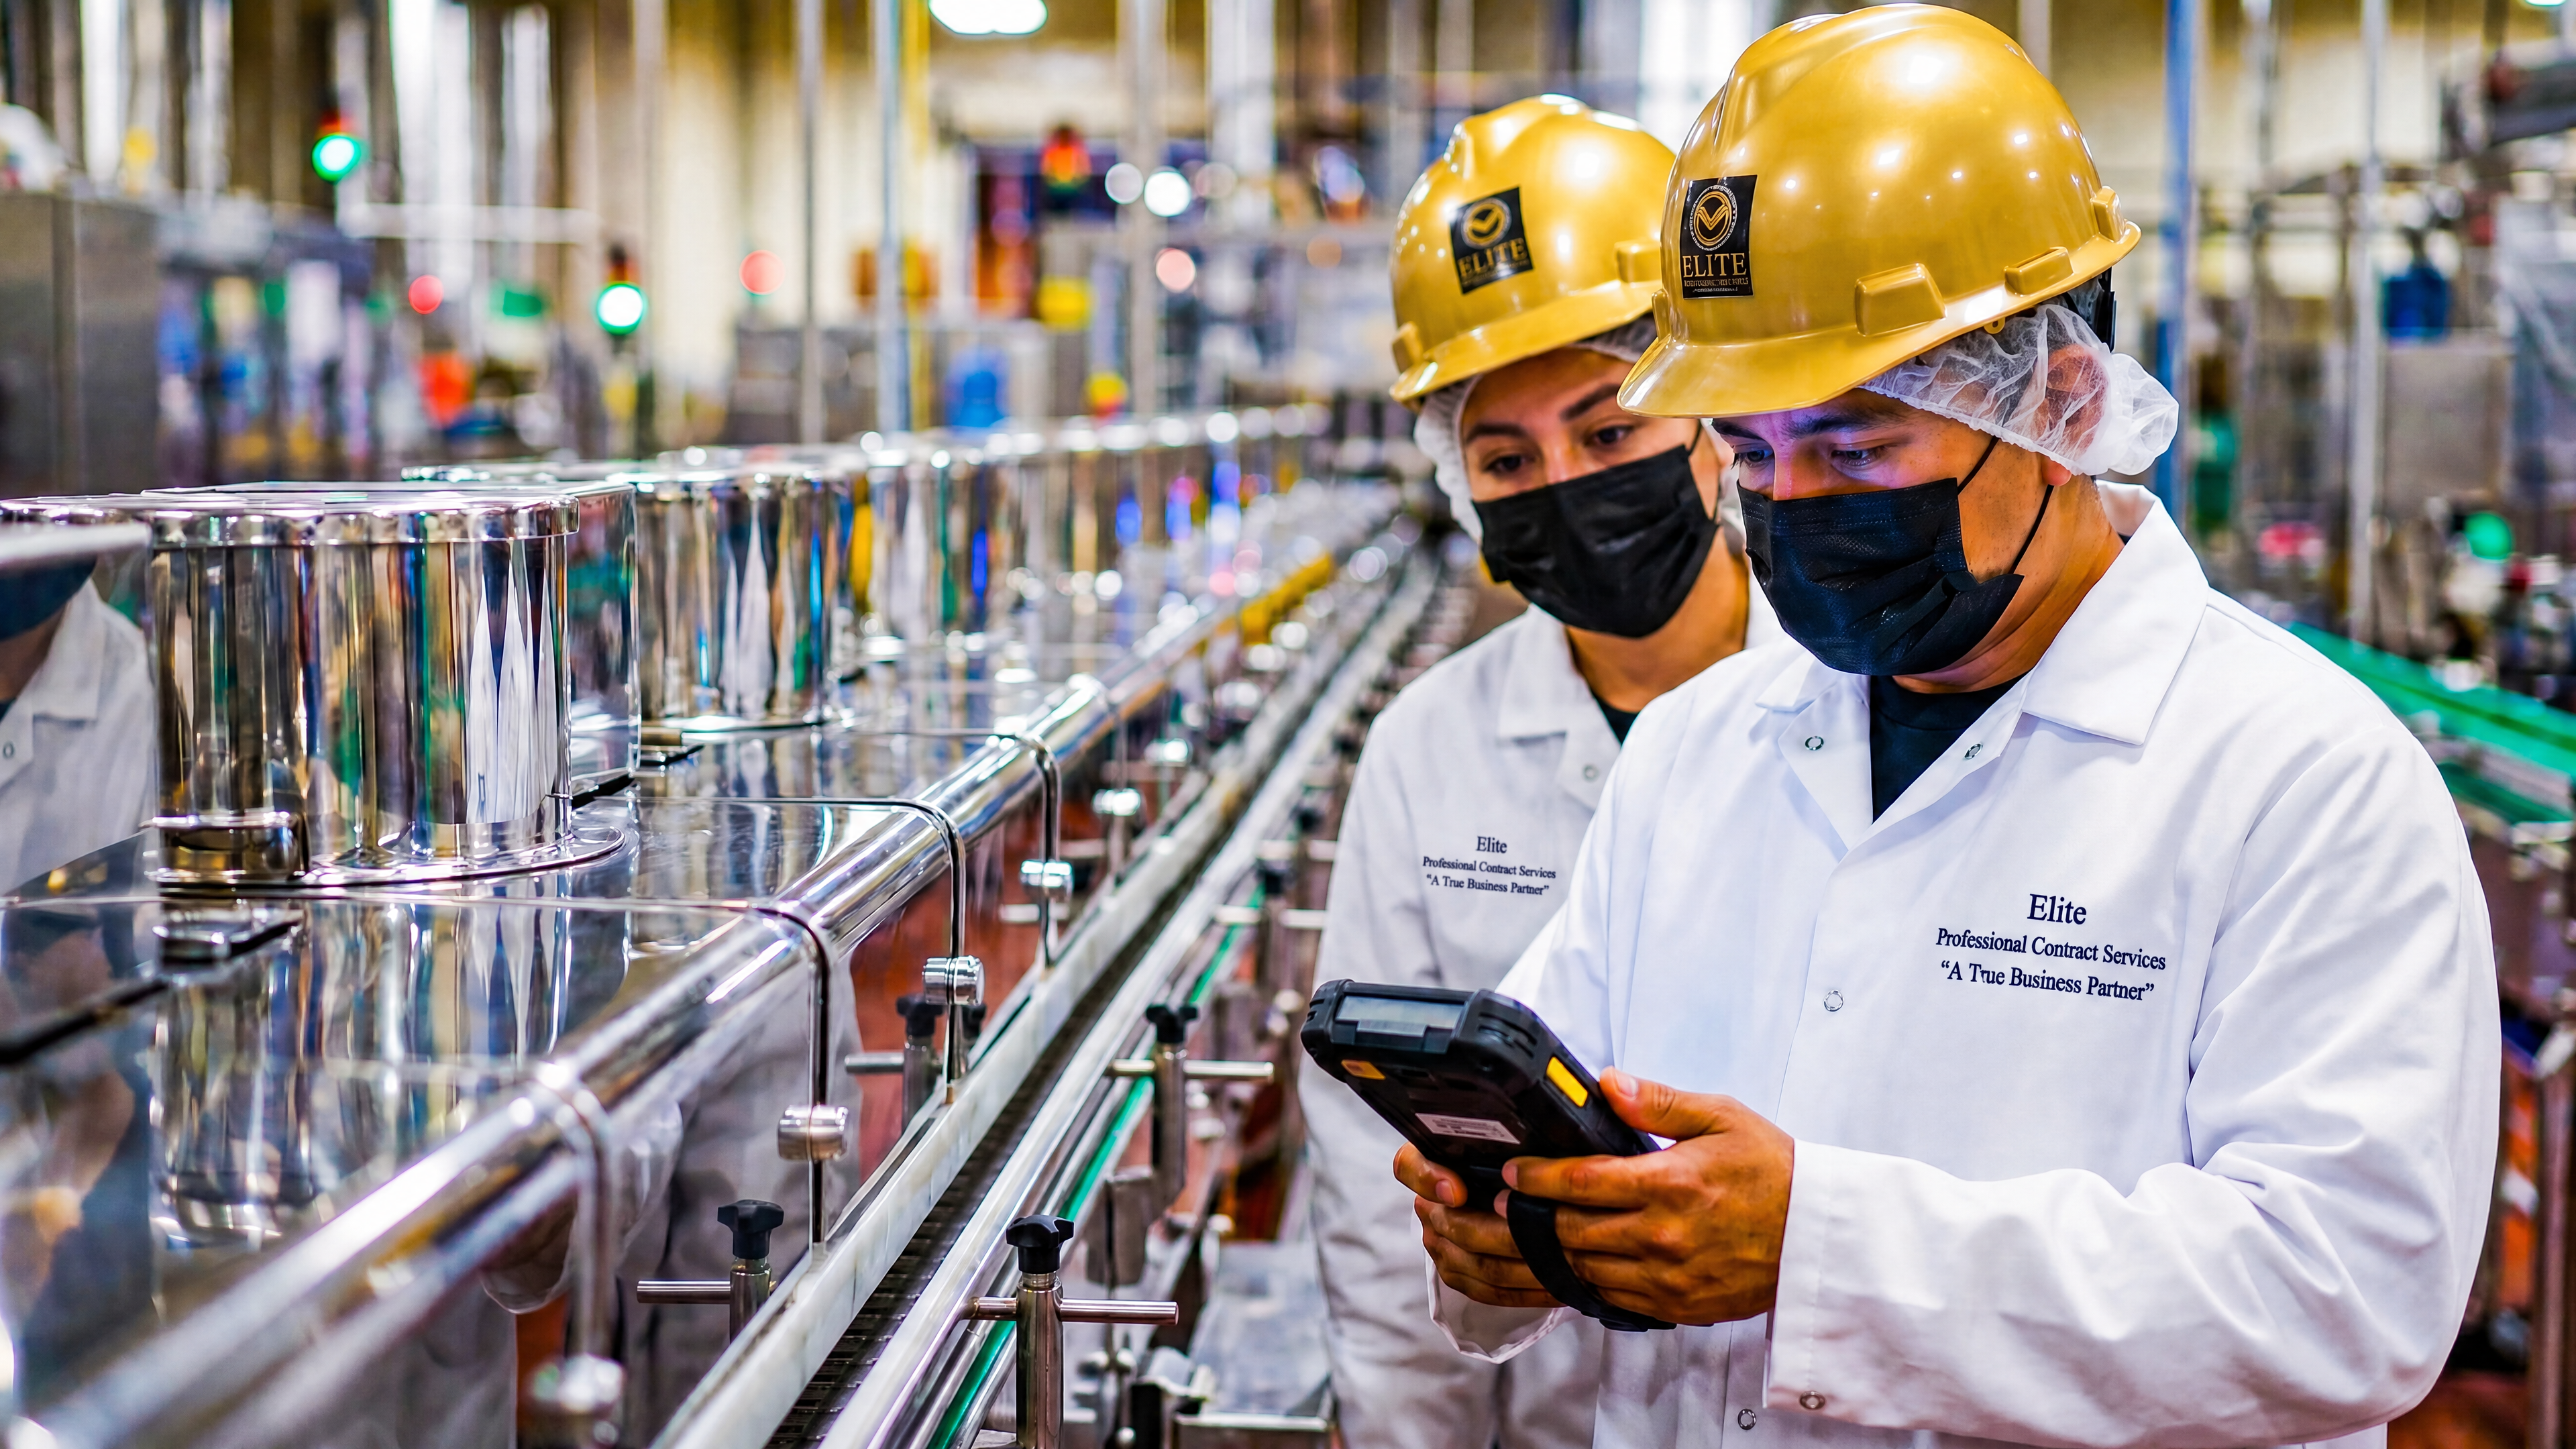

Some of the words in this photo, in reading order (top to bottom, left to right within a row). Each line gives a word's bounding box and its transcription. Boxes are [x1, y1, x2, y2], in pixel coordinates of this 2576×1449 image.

[1458, 237, 1527, 278] ELITE
[1682, 252, 1747, 278] ELITE
[1476, 836, 1507, 853] Elite
[1422, 856, 1477, 871] Professional
[1479, 861, 1517, 875] Contract
[1519, 865, 1556, 879] Services
[1442, 875, 1464, 888] True
[1467, 878, 1508, 892] Business
[2027, 894, 2087, 924] Elite
[1935, 928, 2027, 953] Professional
[2031, 936, 2098, 961] Contract
[2102, 945, 2166, 970] Services
[1941, 960, 1963, 980] “A
[1969, 963, 2005, 985] True
[2009, 967, 2082, 994] Business
[2086, 975, 2155, 1000] Partner”
